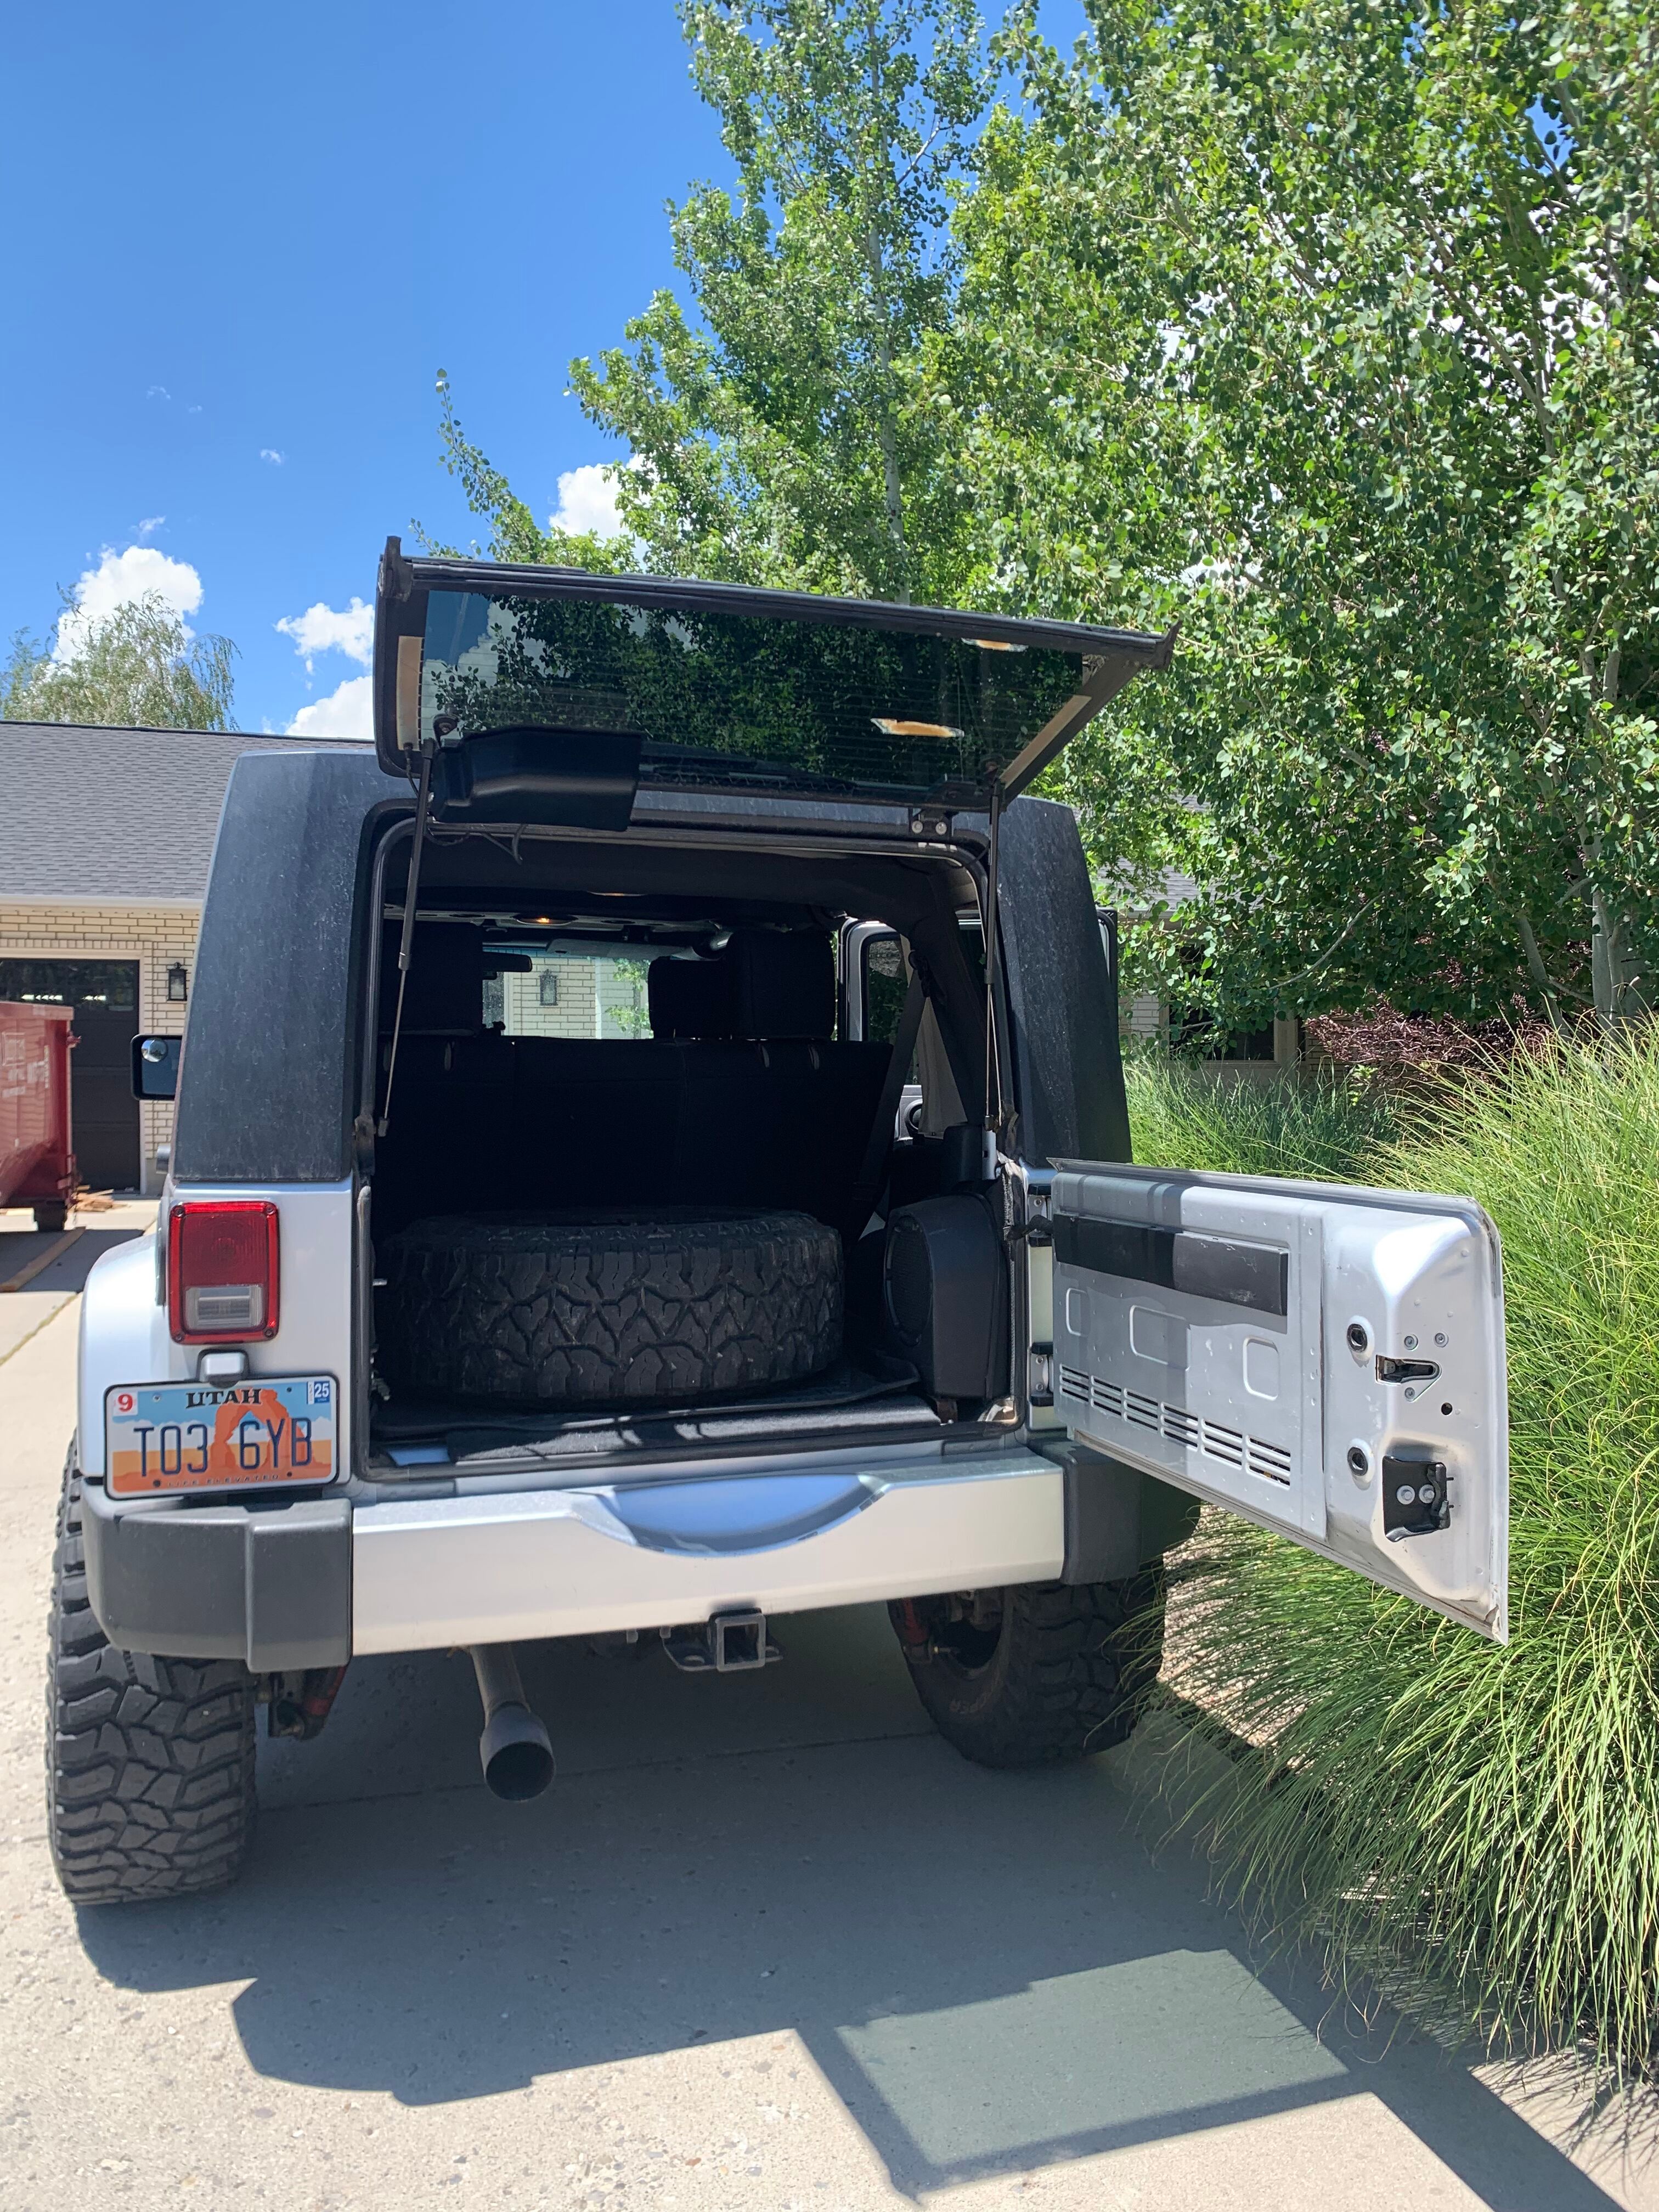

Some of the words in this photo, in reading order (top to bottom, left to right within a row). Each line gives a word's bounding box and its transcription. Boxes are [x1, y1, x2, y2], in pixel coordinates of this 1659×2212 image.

[185, 1389, 262, 1409] UTAH
[314, 1383, 329, 1398] 25
[118, 1393, 133, 1412] 9
[239, 1418, 312, 1470] 6YB
[207, 1475, 279, 1484] ELEVATED
